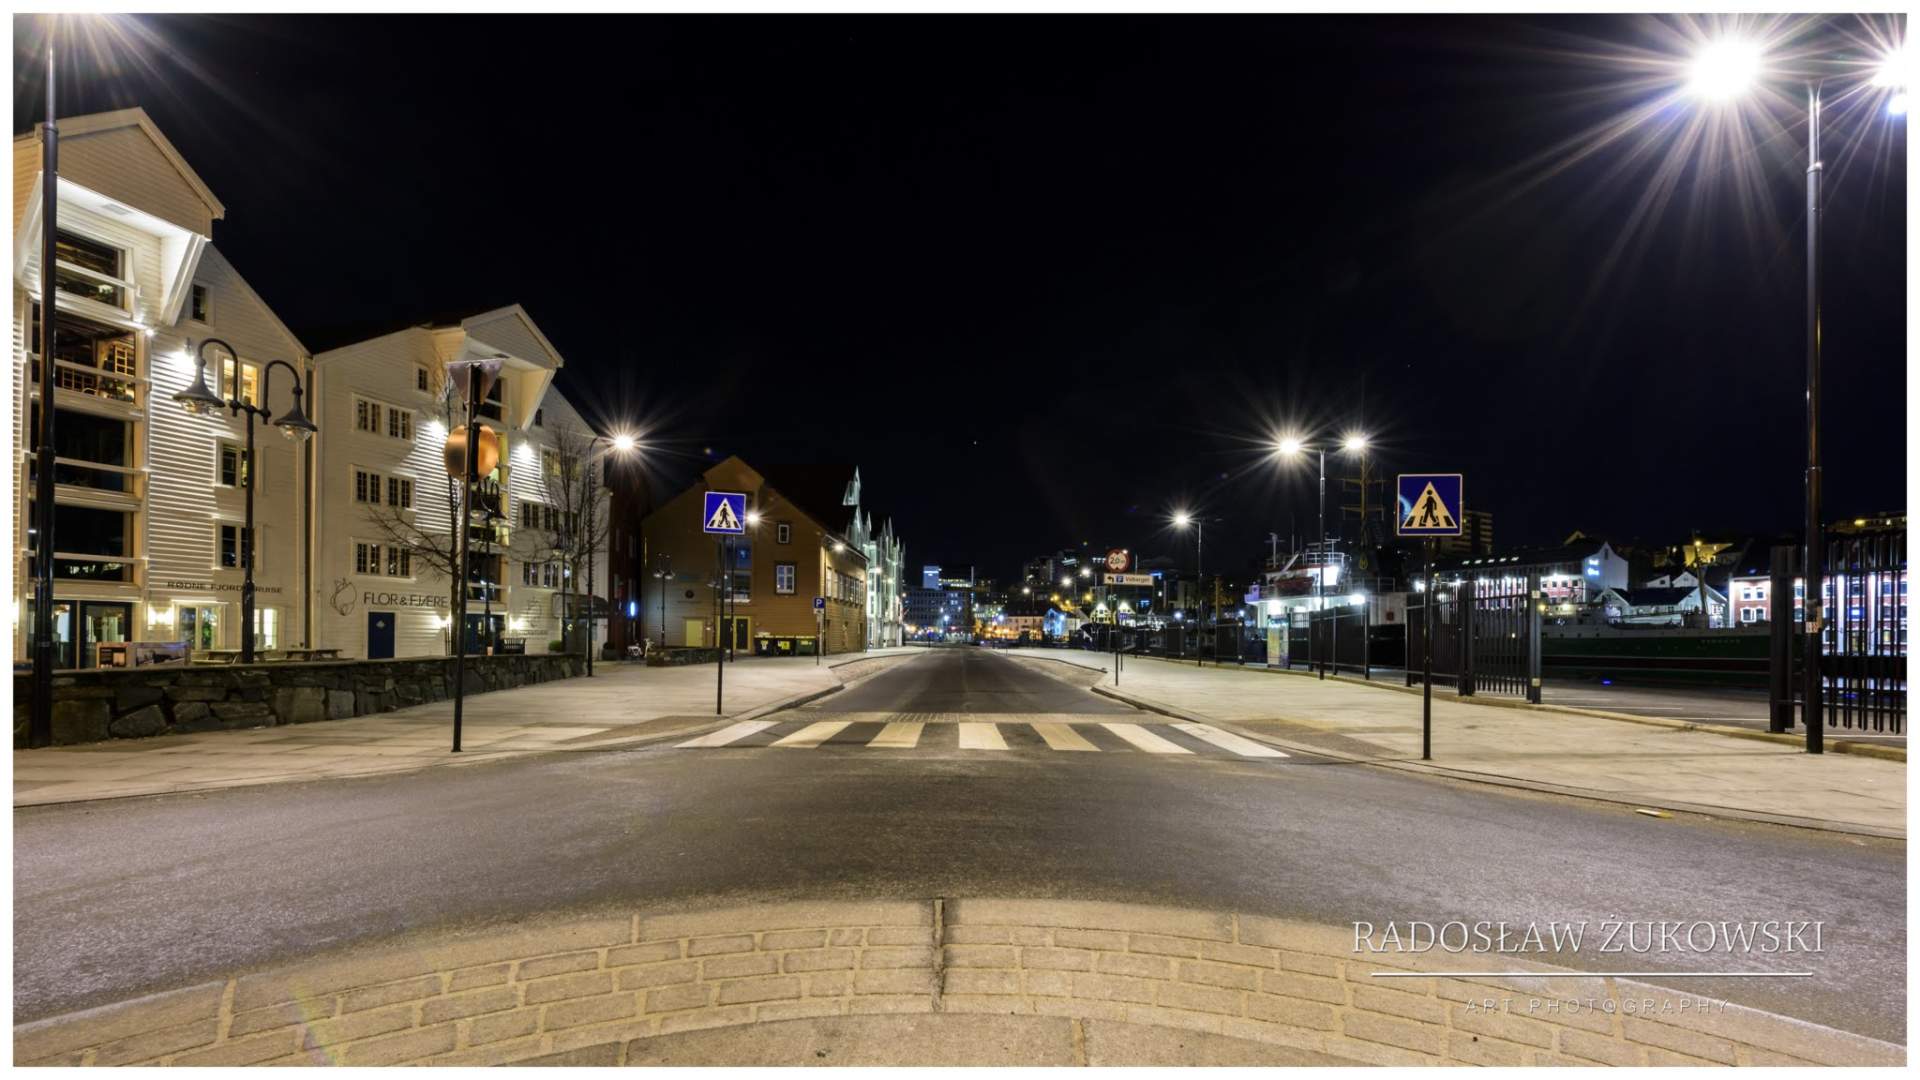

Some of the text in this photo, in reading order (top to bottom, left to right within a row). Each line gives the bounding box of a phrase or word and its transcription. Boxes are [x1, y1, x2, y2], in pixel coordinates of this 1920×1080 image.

[167, 581, 205, 591] RØDNE
[363, 591, 398, 606] FLOR
[399, 595, 408, 606] &
[815, 598, 822, 607] P
